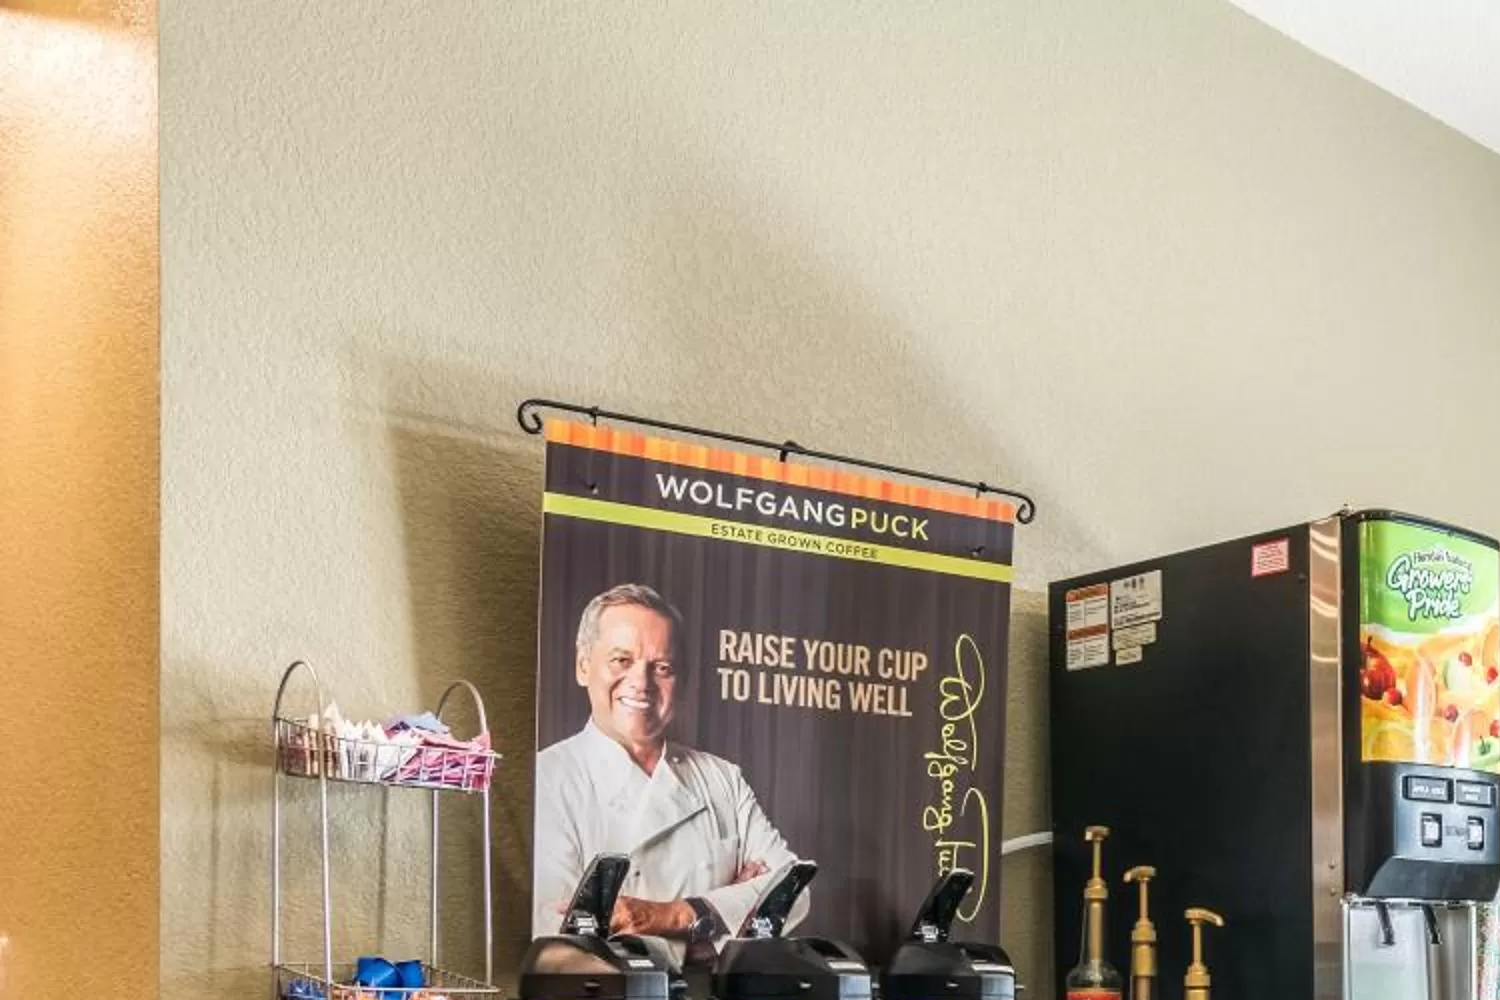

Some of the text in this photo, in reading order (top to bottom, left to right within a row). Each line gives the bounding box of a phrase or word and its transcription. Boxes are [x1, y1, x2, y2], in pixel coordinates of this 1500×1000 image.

[711, 523, 879, 559] ESTATE GROWN COFFEE
[719, 629, 929, 683] RAISE YOUR CUP
[717, 667, 913, 717] TO LIVING WELL
